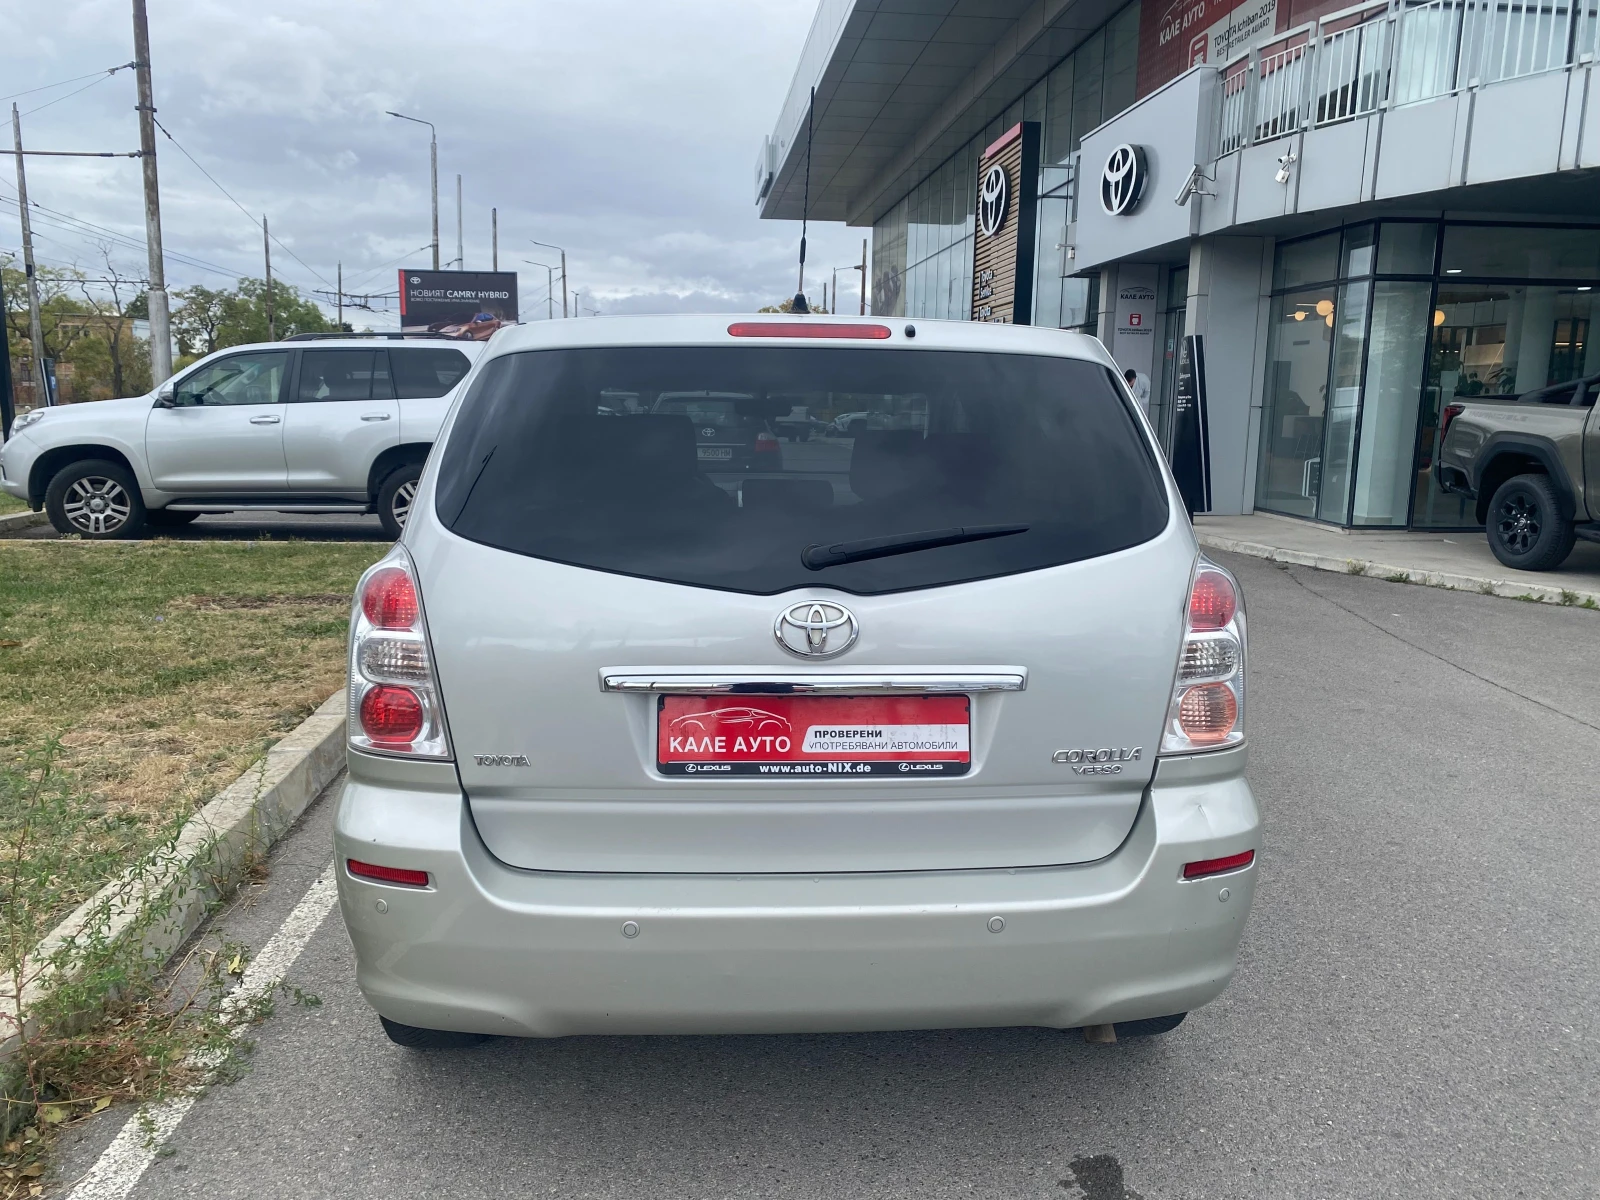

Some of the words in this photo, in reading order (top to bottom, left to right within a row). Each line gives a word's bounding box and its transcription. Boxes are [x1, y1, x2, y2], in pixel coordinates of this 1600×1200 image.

[1159, 18, 1181, 46] КАЛЕ
[1182, 1, 1205, 31] АУТО
[1214, 25, 1237, 48] TOYOTA
[1237, 12, 1259, 33] Ichiban
[1259, 0, 1276, 18] 2019
[410, 289, 445, 297] НОВИЯТ
[446, 290, 476, 298] CAMRY
[478, 291, 509, 299] HYBRID
[814, 730, 883, 739] ПРОВЕРЕНИ
[669, 736, 727, 753] КАЛЕ
[733, 735, 791, 753] АУТО
[808, 741, 888, 750] УПОТРЕБЯВАНИ
[890, 741, 958, 750] АВТОМОБИЛИ
[473, 754, 531, 767] TOYOTA
[1052, 746, 1143, 764] COROLLA
[759, 763, 872, 773] www.auto-NIX.de
[1071, 764, 1123, 776] VERSO
